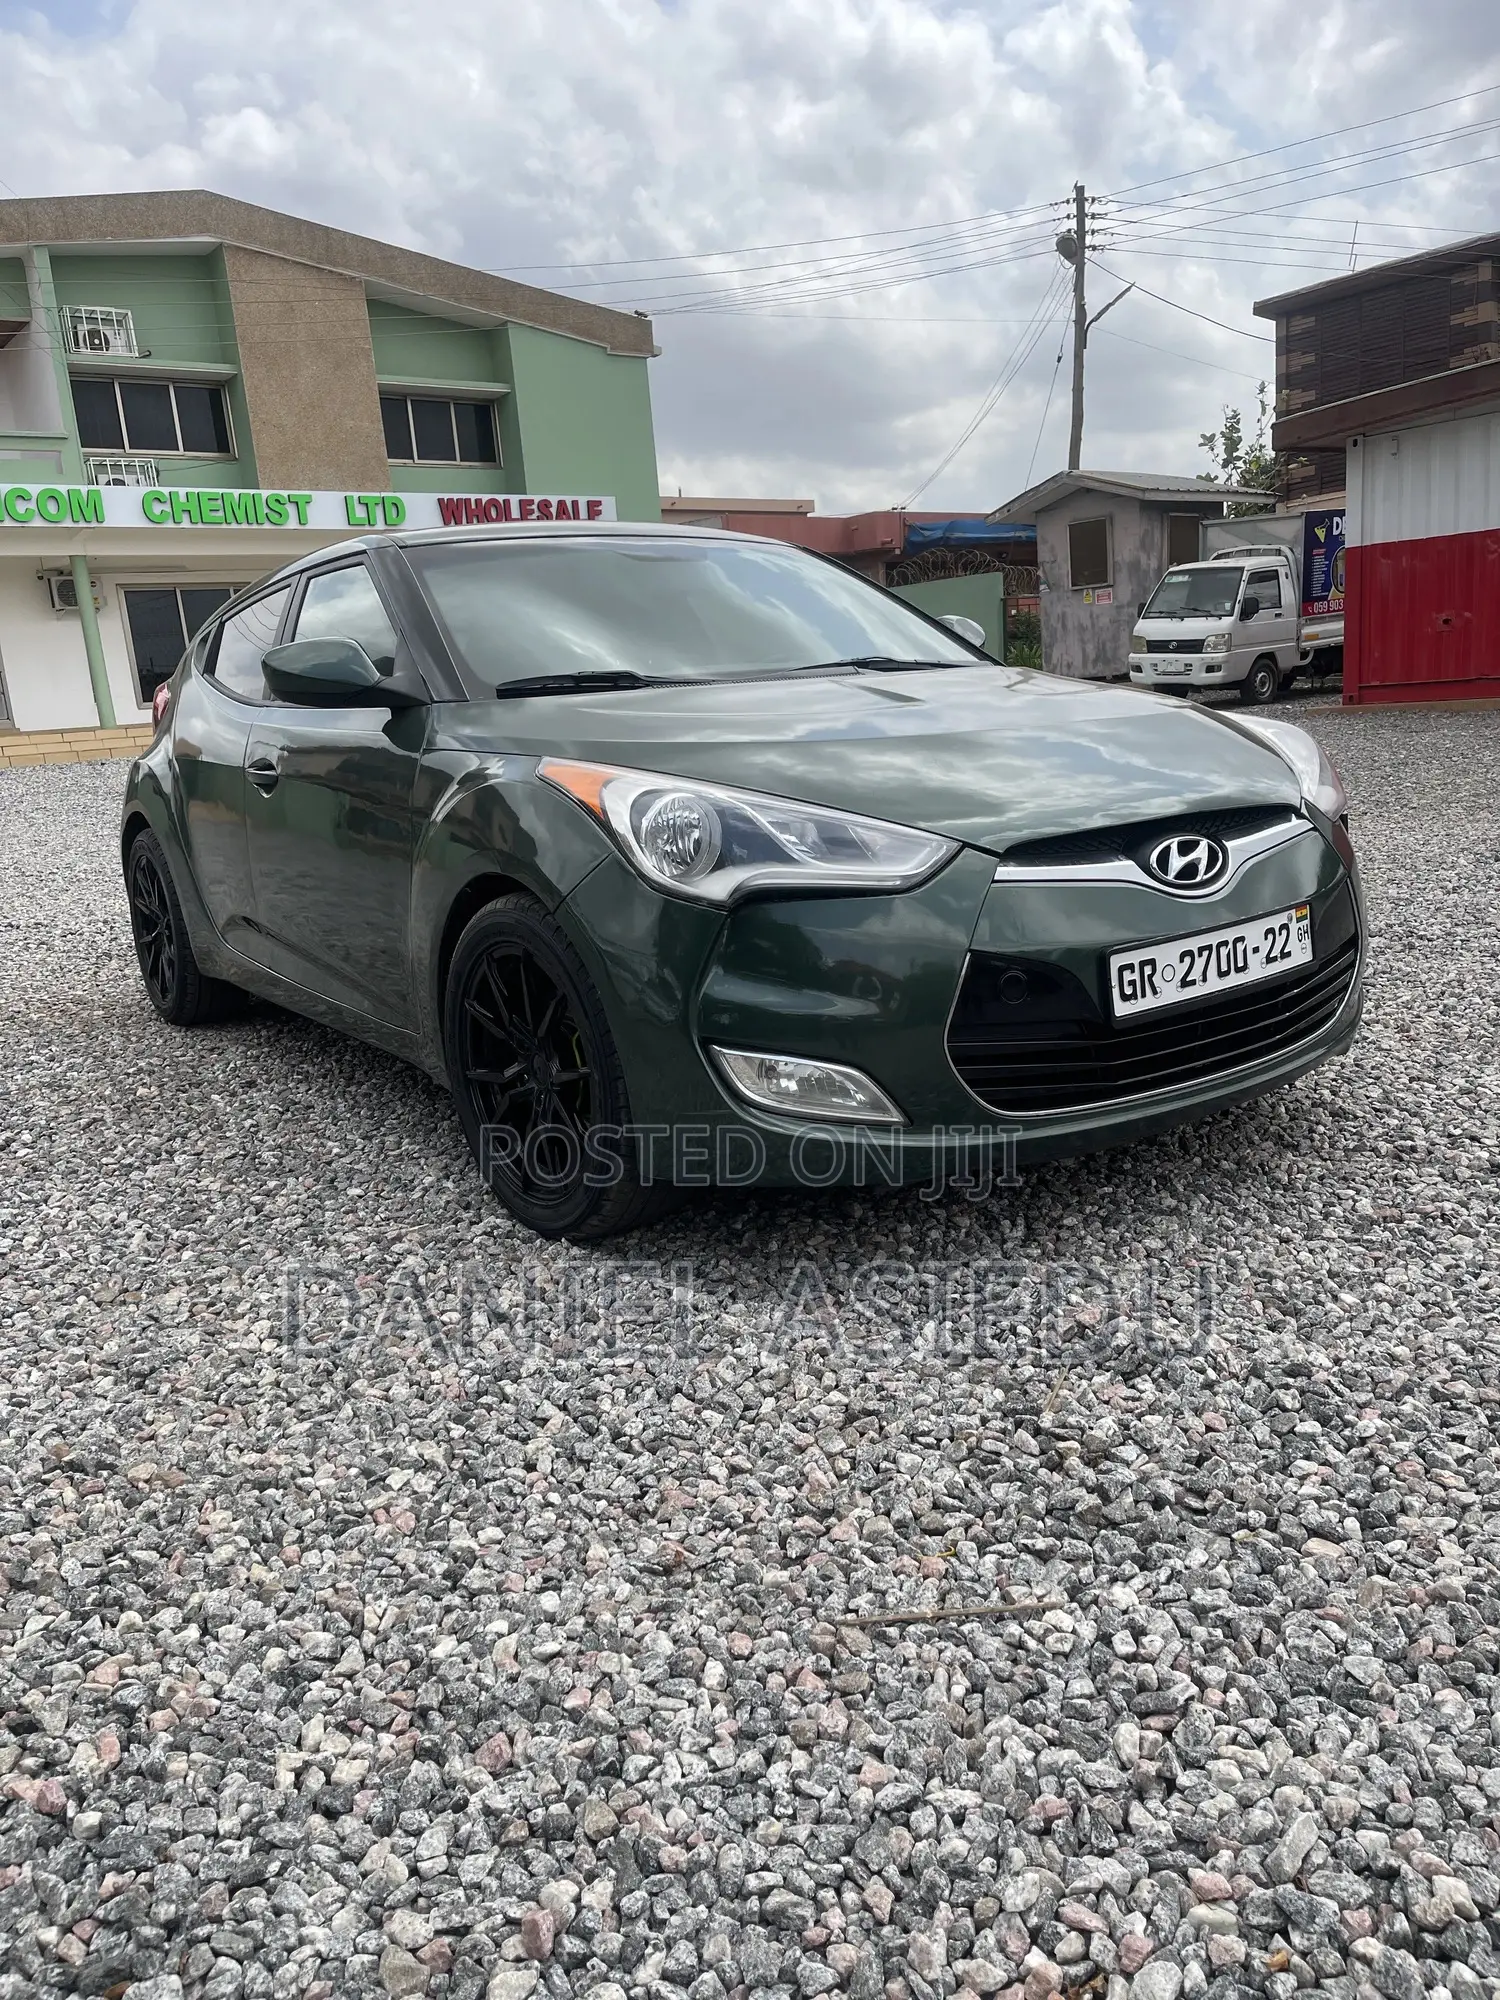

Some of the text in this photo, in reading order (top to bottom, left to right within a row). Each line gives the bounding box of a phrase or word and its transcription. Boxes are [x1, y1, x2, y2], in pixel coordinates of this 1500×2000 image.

[0, 487, 603, 526] COM CHEMIST LTD WHOLESALE
[1313, 599, 1344, 613] 059 903
[1297, 923, 1310, 943] GH
[1117, 957, 1159, 1002] GR
